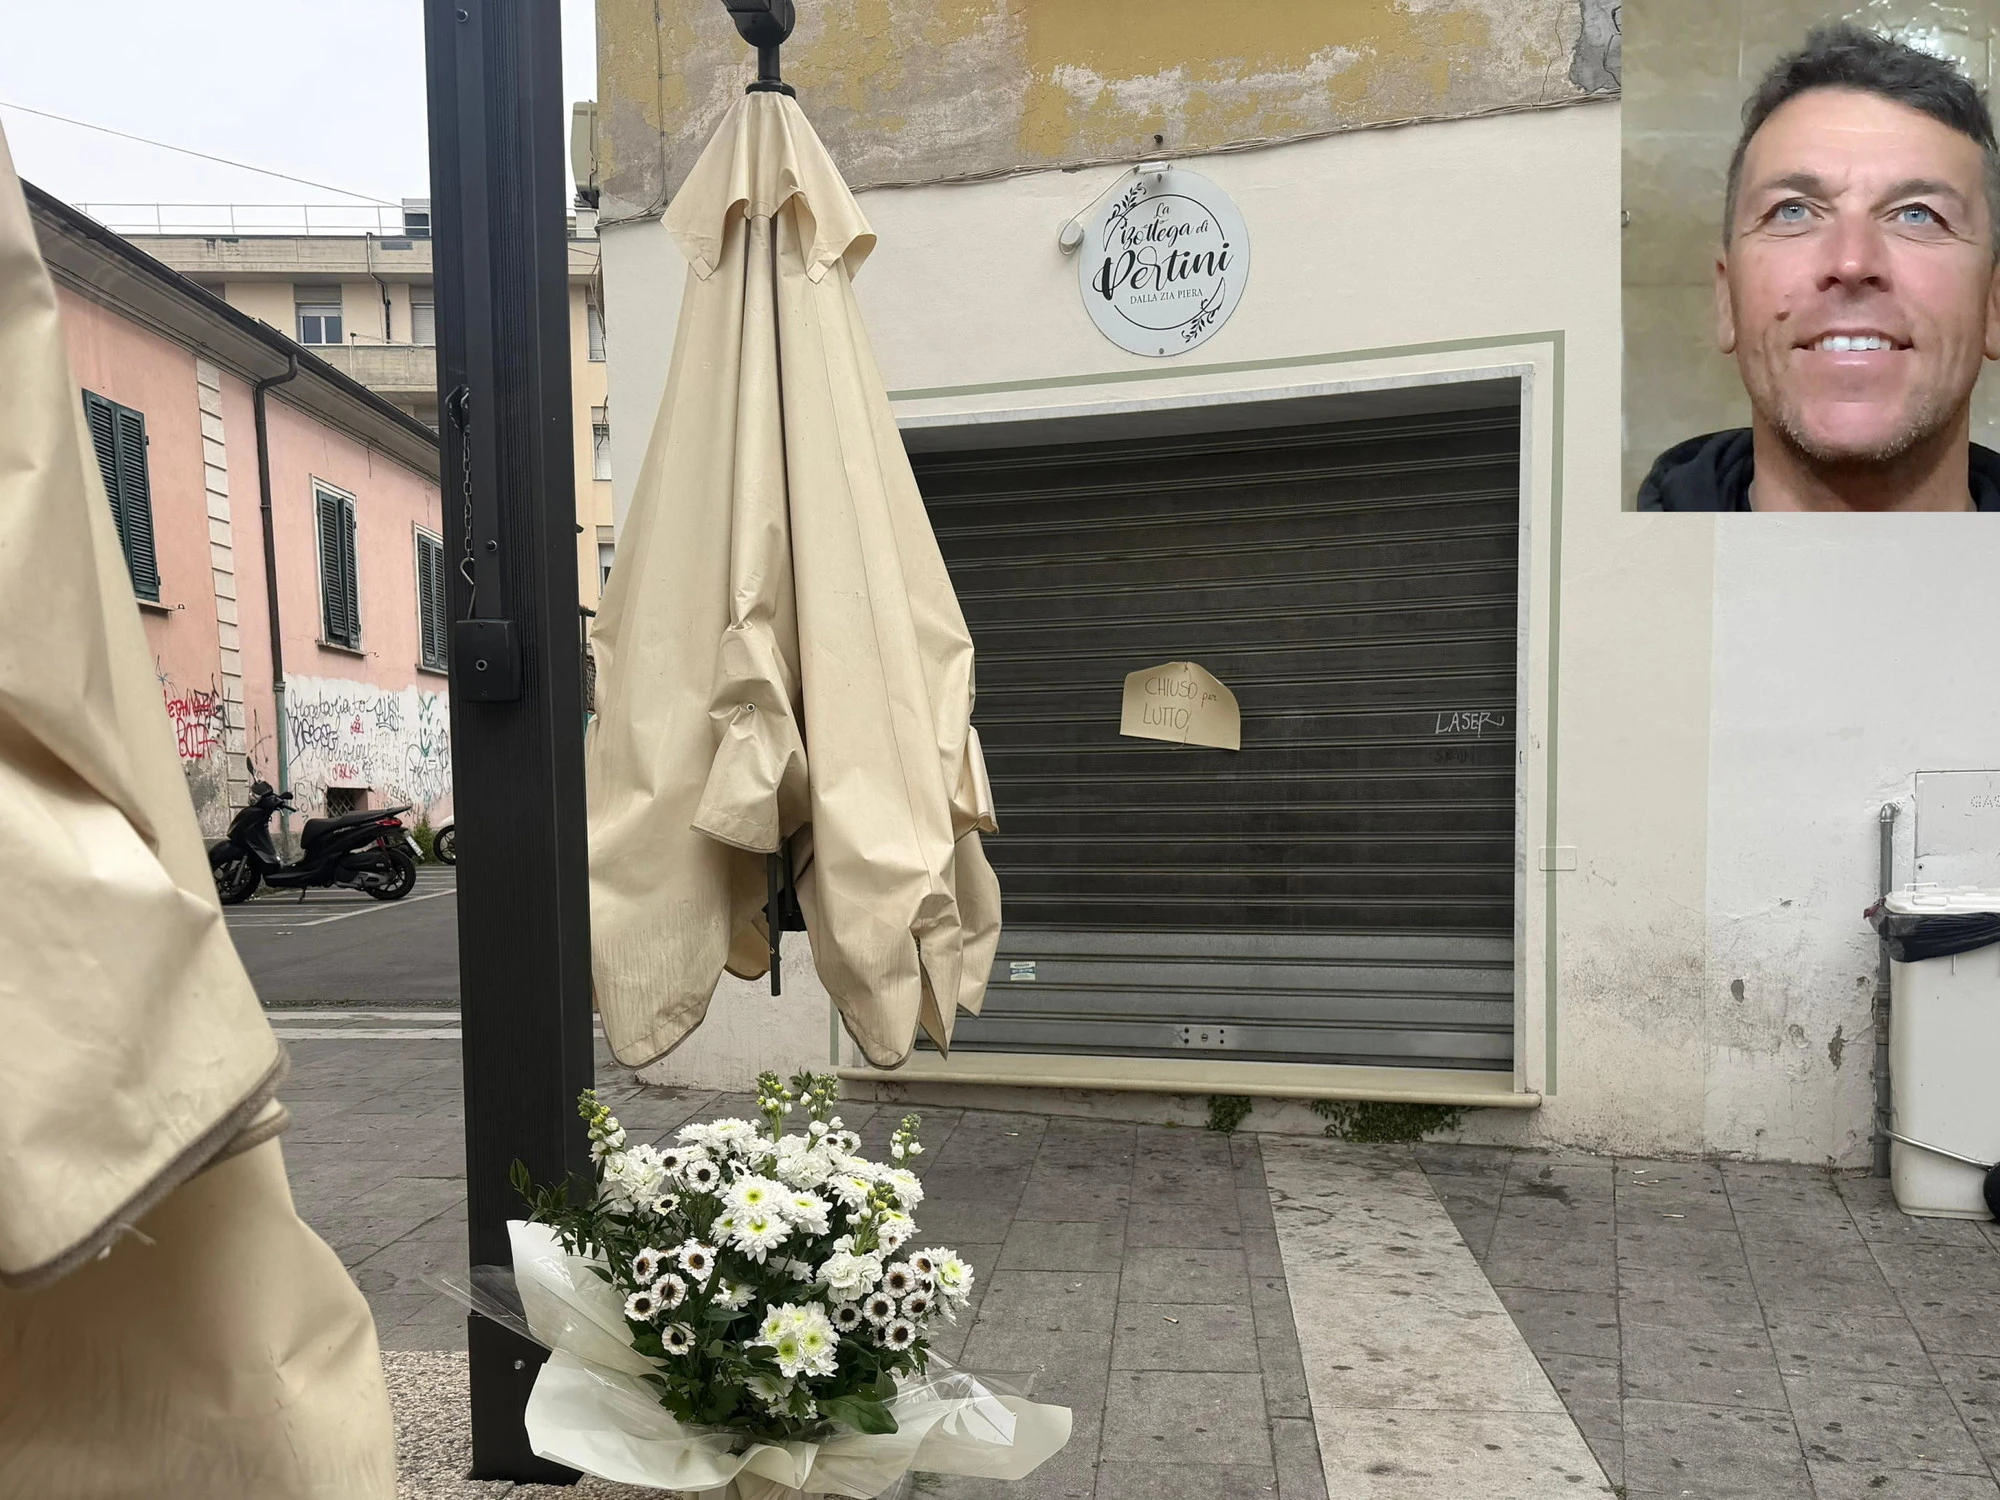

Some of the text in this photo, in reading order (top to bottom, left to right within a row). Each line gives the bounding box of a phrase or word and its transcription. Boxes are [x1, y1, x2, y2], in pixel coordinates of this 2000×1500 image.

[1153, 202, 1171, 220] La
[1121, 219, 1209, 250] Bottega di
[1092, 242, 1234, 301] Pertini
[1130, 288, 1204, 304] DALLA ZIA PIERA
[1144, 677, 1198, 700] CHIUSO
[1142, 702, 1189, 730] LUTTO
[1435, 711, 1505, 738] LASER
